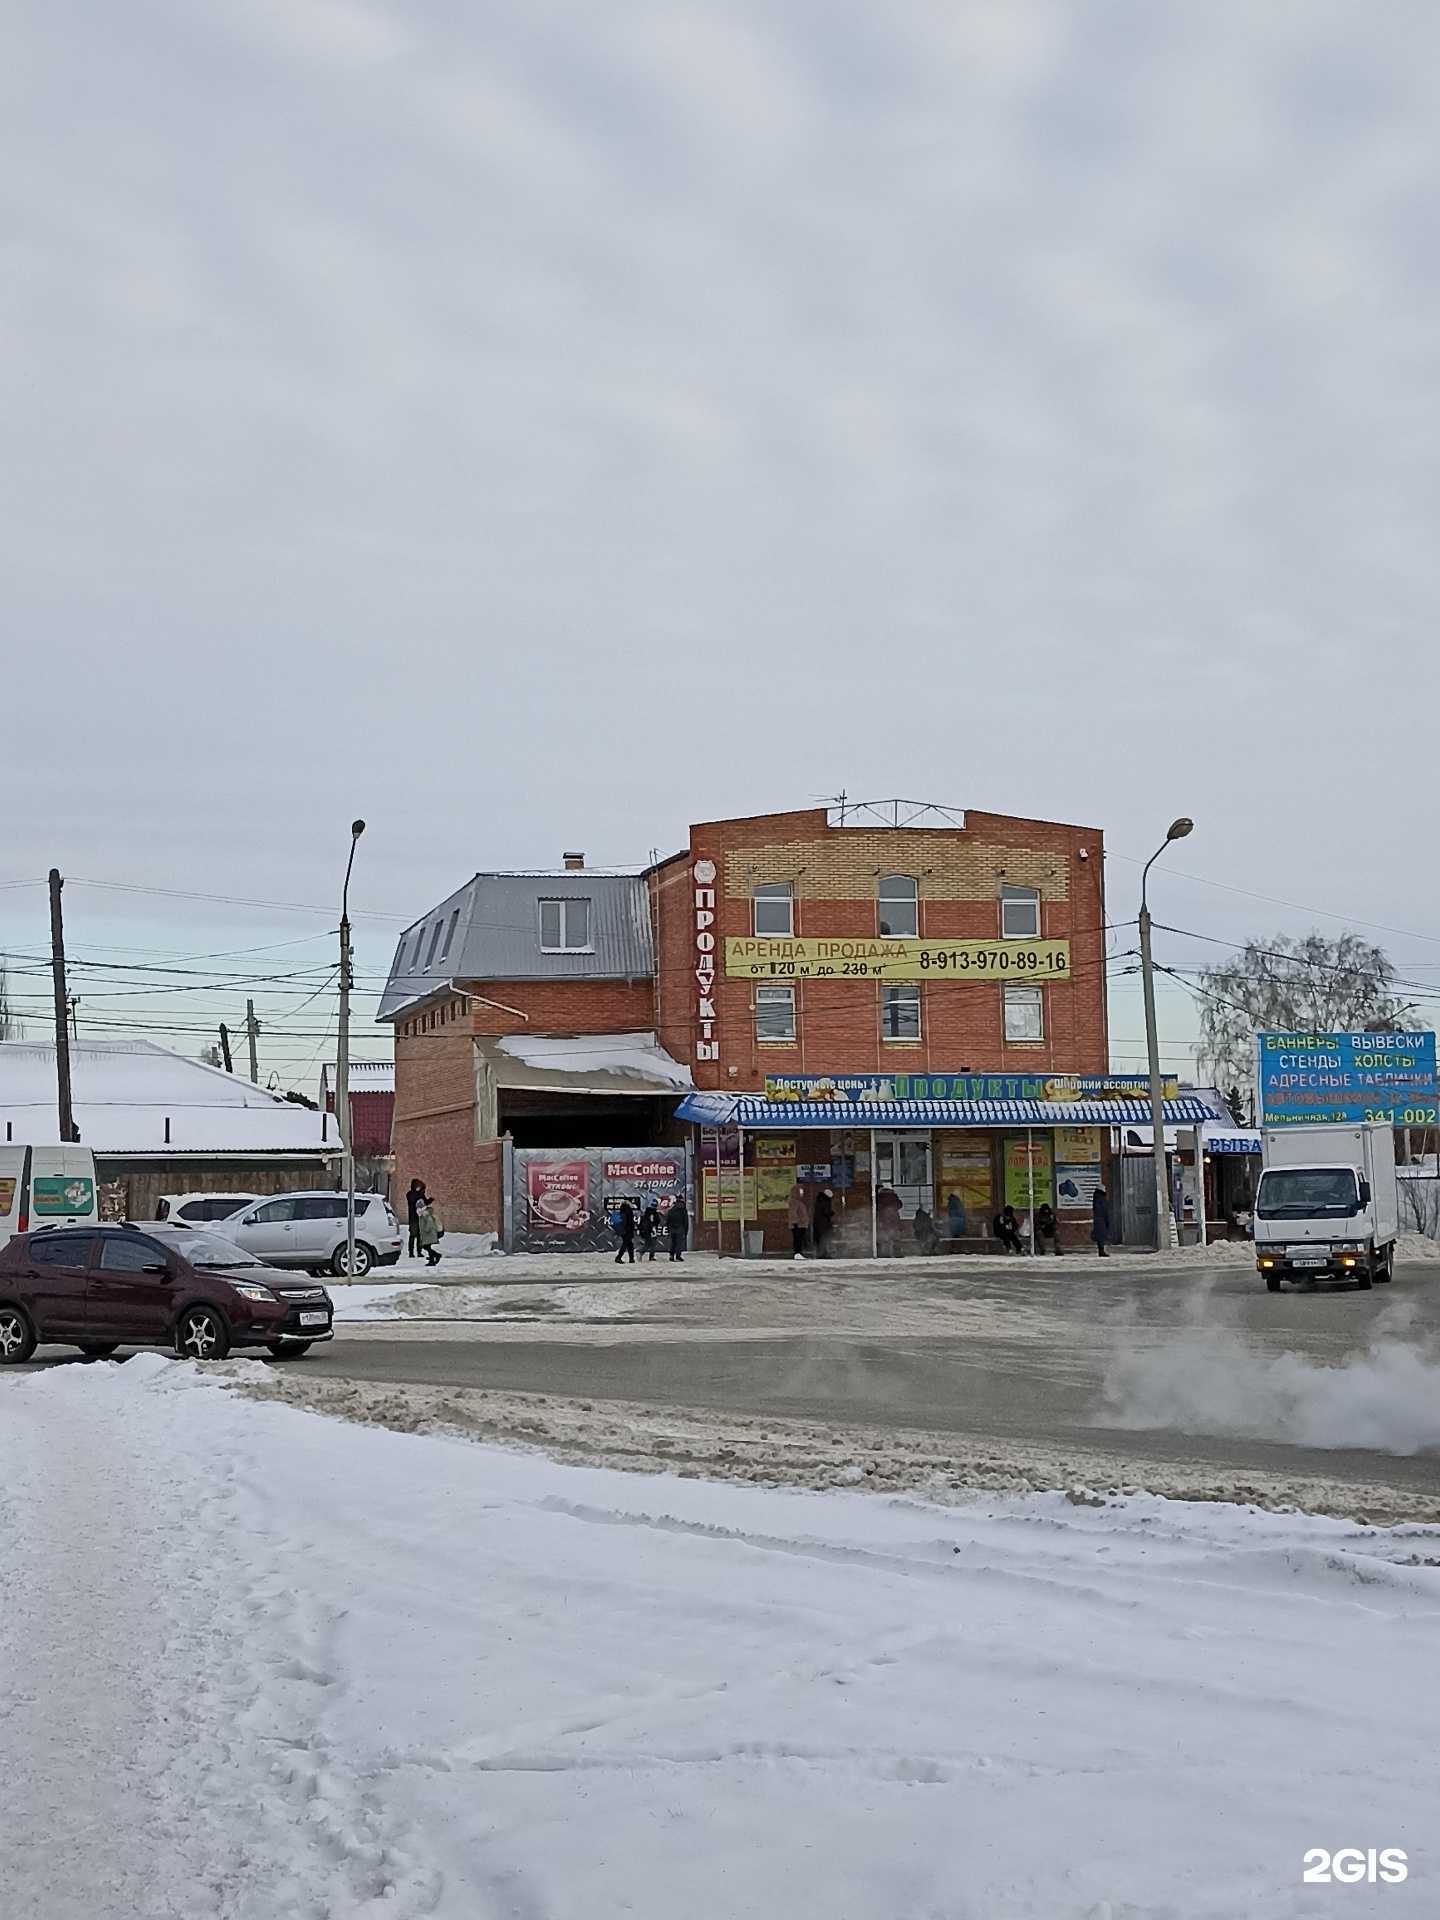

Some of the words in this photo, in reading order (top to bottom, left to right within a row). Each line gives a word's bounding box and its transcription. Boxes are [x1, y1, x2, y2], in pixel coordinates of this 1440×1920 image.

[732, 942, 806, 959] АРЕНДА
[817, 943, 907, 960] ПРОДАЖА
[919, 951, 1066, 970] 8-913-970-89-16
[695, 888, 719, 1060] ПРОДУКТЫ
[750, 965, 765, 975] от
[817, 966, 834, 976] до
[842, 962, 868, 975] 230
[1266, 1036, 1339, 1050] БАННЕРЫ
[1351, 1035, 1425, 1049] ВЫВЕСКИ
[1279, 1054, 1342, 1069] СТЕНДЫ
[1354, 1054, 1416, 1068] ХОЛСТЫ
[1269, 1072, 1352, 1088] АДРЕСНЫЕ
[1357, 1072, 1433, 1087] ТАБЛИЧКИ
[1363, 1109, 1436, 1123] 341-002
[1208, 1139, 1262, 1152] РЫБА
[607, 1163, 675, 1176] MacCoffee
